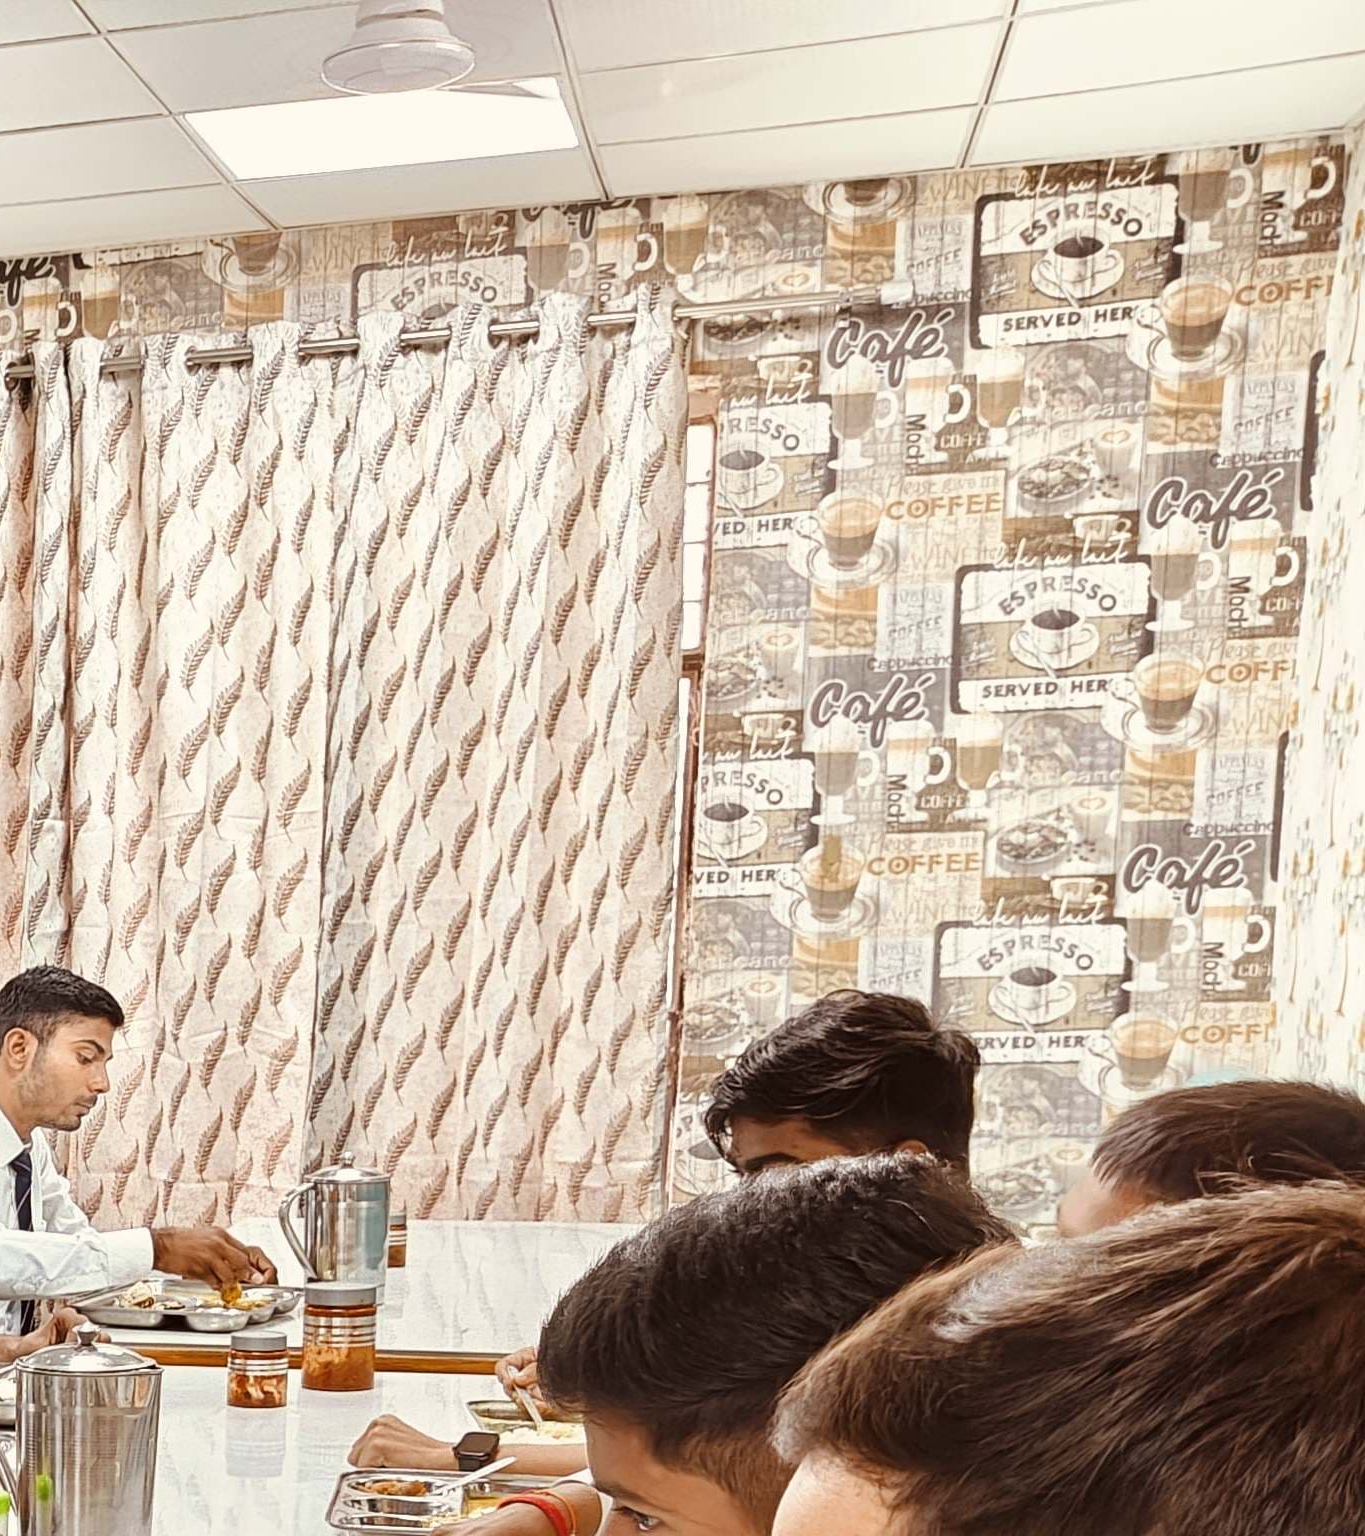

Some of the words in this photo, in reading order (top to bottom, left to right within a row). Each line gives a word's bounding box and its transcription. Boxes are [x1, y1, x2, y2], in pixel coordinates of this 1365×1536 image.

[1019, 200, 1144, 247] ESPRESSO
[390, 269, 499, 311] ESPRESSO
[1235, 275, 1334, 307] COFF
[1003, 311, 1082, 333] SERVED
[1093, 304, 1139, 325] HER
[826, 309, 955, 389] Café
[906, 414, 926, 471] Moch
[939, 432, 987, 450] COFFE
[885, 491, 1003, 521] COFFEE
[1146, 469, 1284, 550] Café
[757, 516, 797, 533] HER
[998, 575, 1117, 616] ESPRESSO
[1227, 576, 1252, 635] Moch
[981, 681, 1059, 699] SERVED
[1070, 678, 1113, 694] HER
[1204, 659, 1297, 684] COFF
[809, 673, 936, 749] Café
[887, 773, 908, 828] Moch
[921, 795, 965, 809] COFFE
[741, 868, 782, 884] HER
[868, 853, 981, 876] COFFEE
[1123, 840, 1255, 916] Café
[977, 934, 1095, 972] ESPRESSO
[1201, 941, 1225, 998] Moch
[974, 1035, 1037, 1051] ERVED
[1048, 1034, 1090, 1049] HER
[1180, 1022, 1269, 1044] COFF
